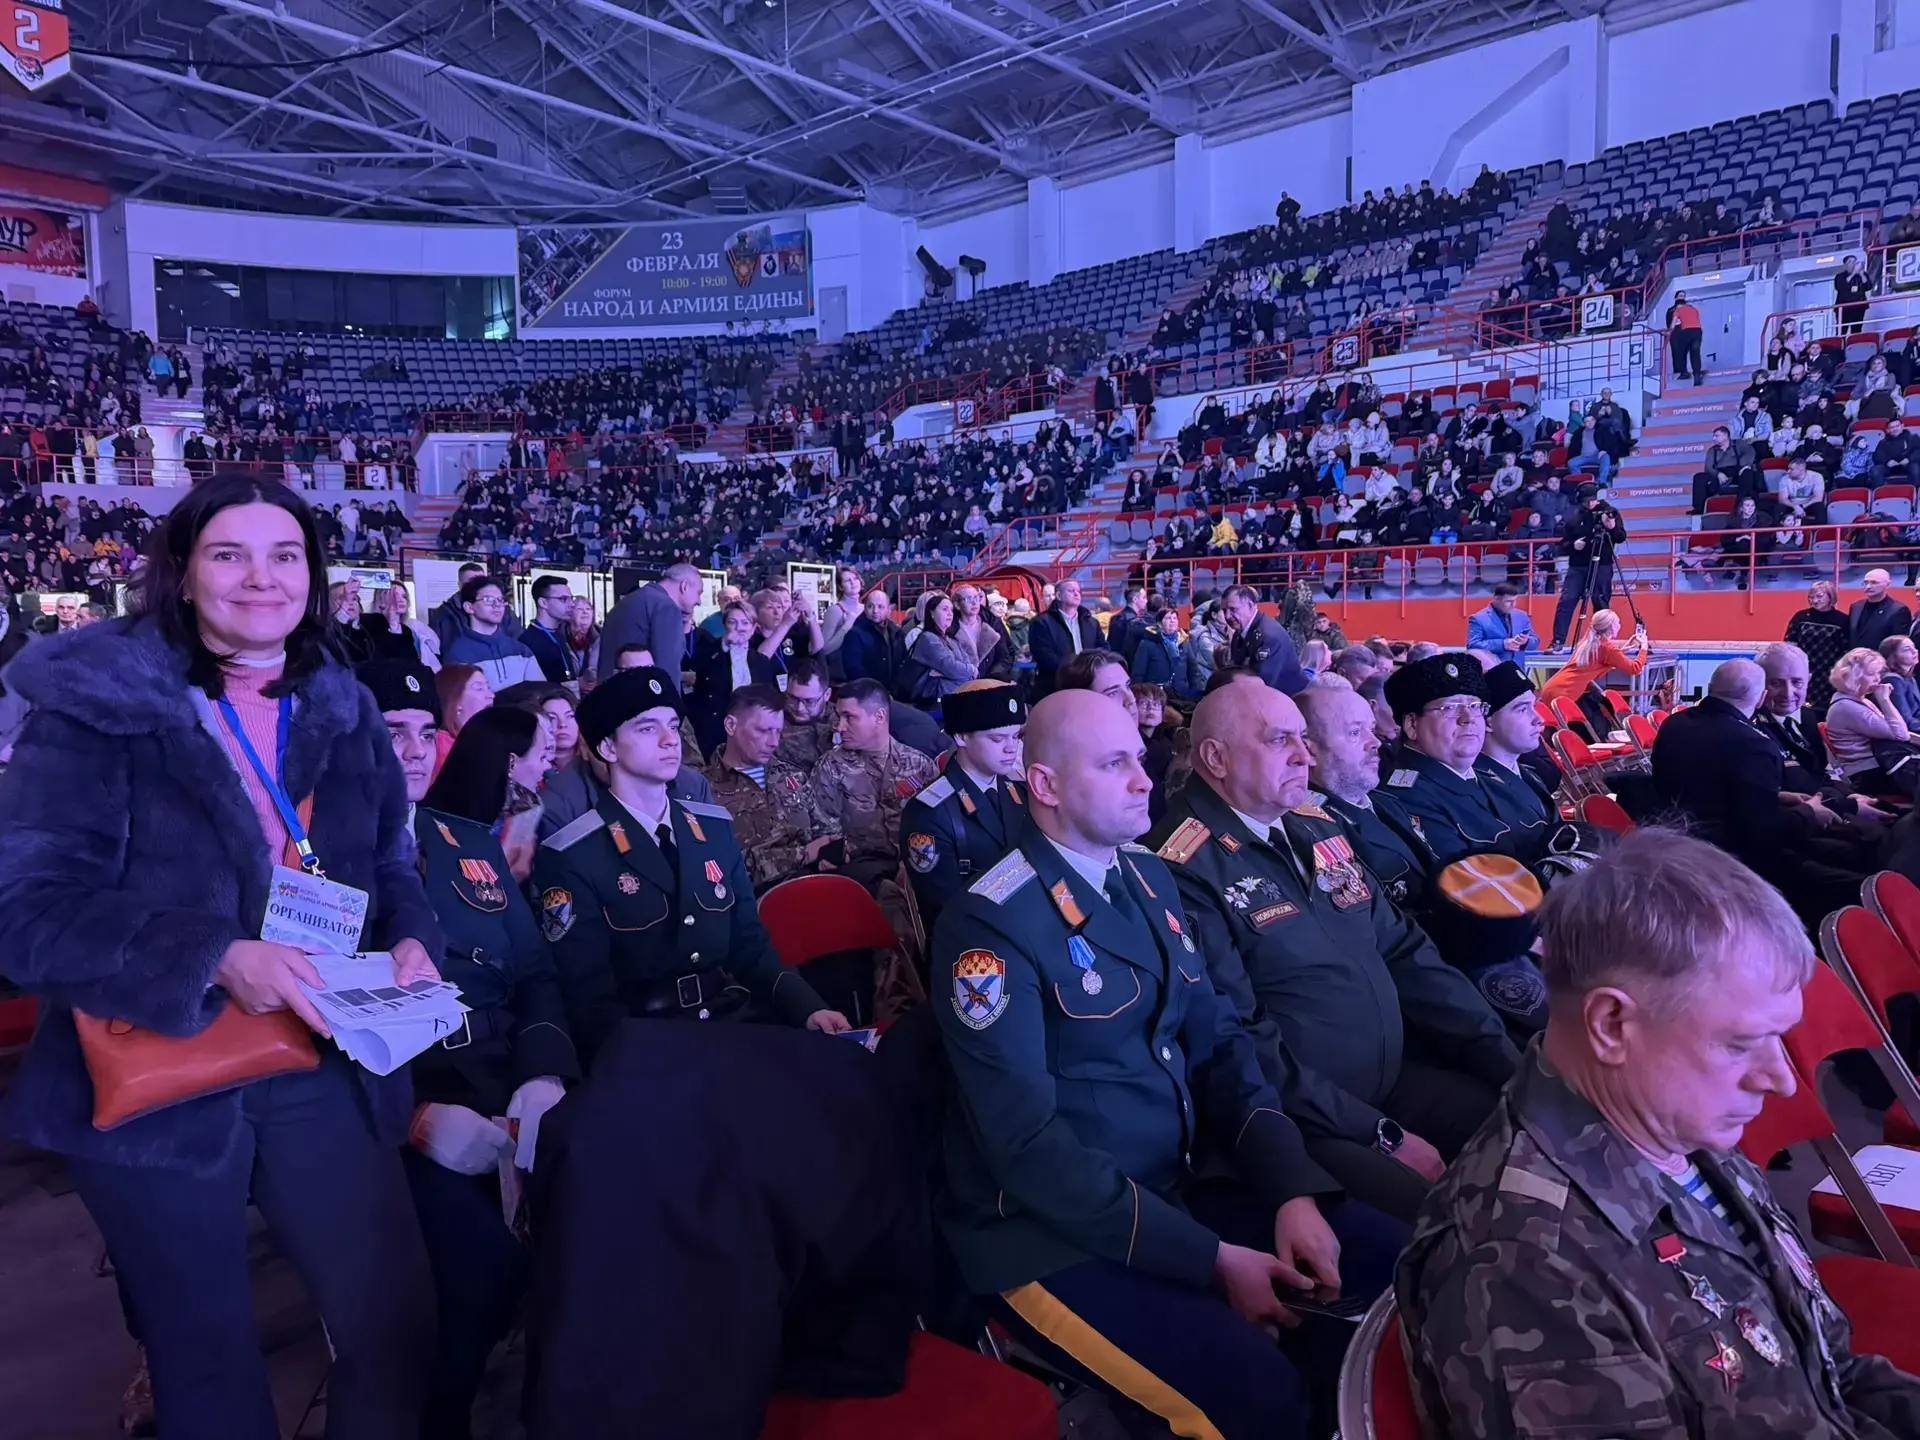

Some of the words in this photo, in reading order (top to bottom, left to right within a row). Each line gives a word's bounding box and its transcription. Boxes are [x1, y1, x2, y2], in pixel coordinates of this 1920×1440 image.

[15, 9, 40, 51] 2
[661, 232, 684, 250] 23
[626, 253, 720, 273] ФЕВРАЛЯ
[1902, 253, 1920, 278] 2
[661, 277, 690, 290] 10:00
[699, 275, 728, 288] 19:00
[593, 287, 632, 299] ФОРУМ
[563, 300, 635, 319] НАРОД
[639, 299, 654, 315] И
[659, 296, 730, 315] АРМИЯ
[734, 290, 805, 314] ЕДИНЫ
[1586, 300, 1610, 324] 24
[1336, 341, 1354, 361] 23
[960, 404, 973, 420] 22
[1629, 488, 1662, 497] ТЕРРИТОРИЯ
[1663, 487, 1684, 495] ТИГРОВ
[269, 903, 360, 938] ОРГАНИЗАТОР
[1254, 905, 1293, 923] НОВОРОССИЯ
